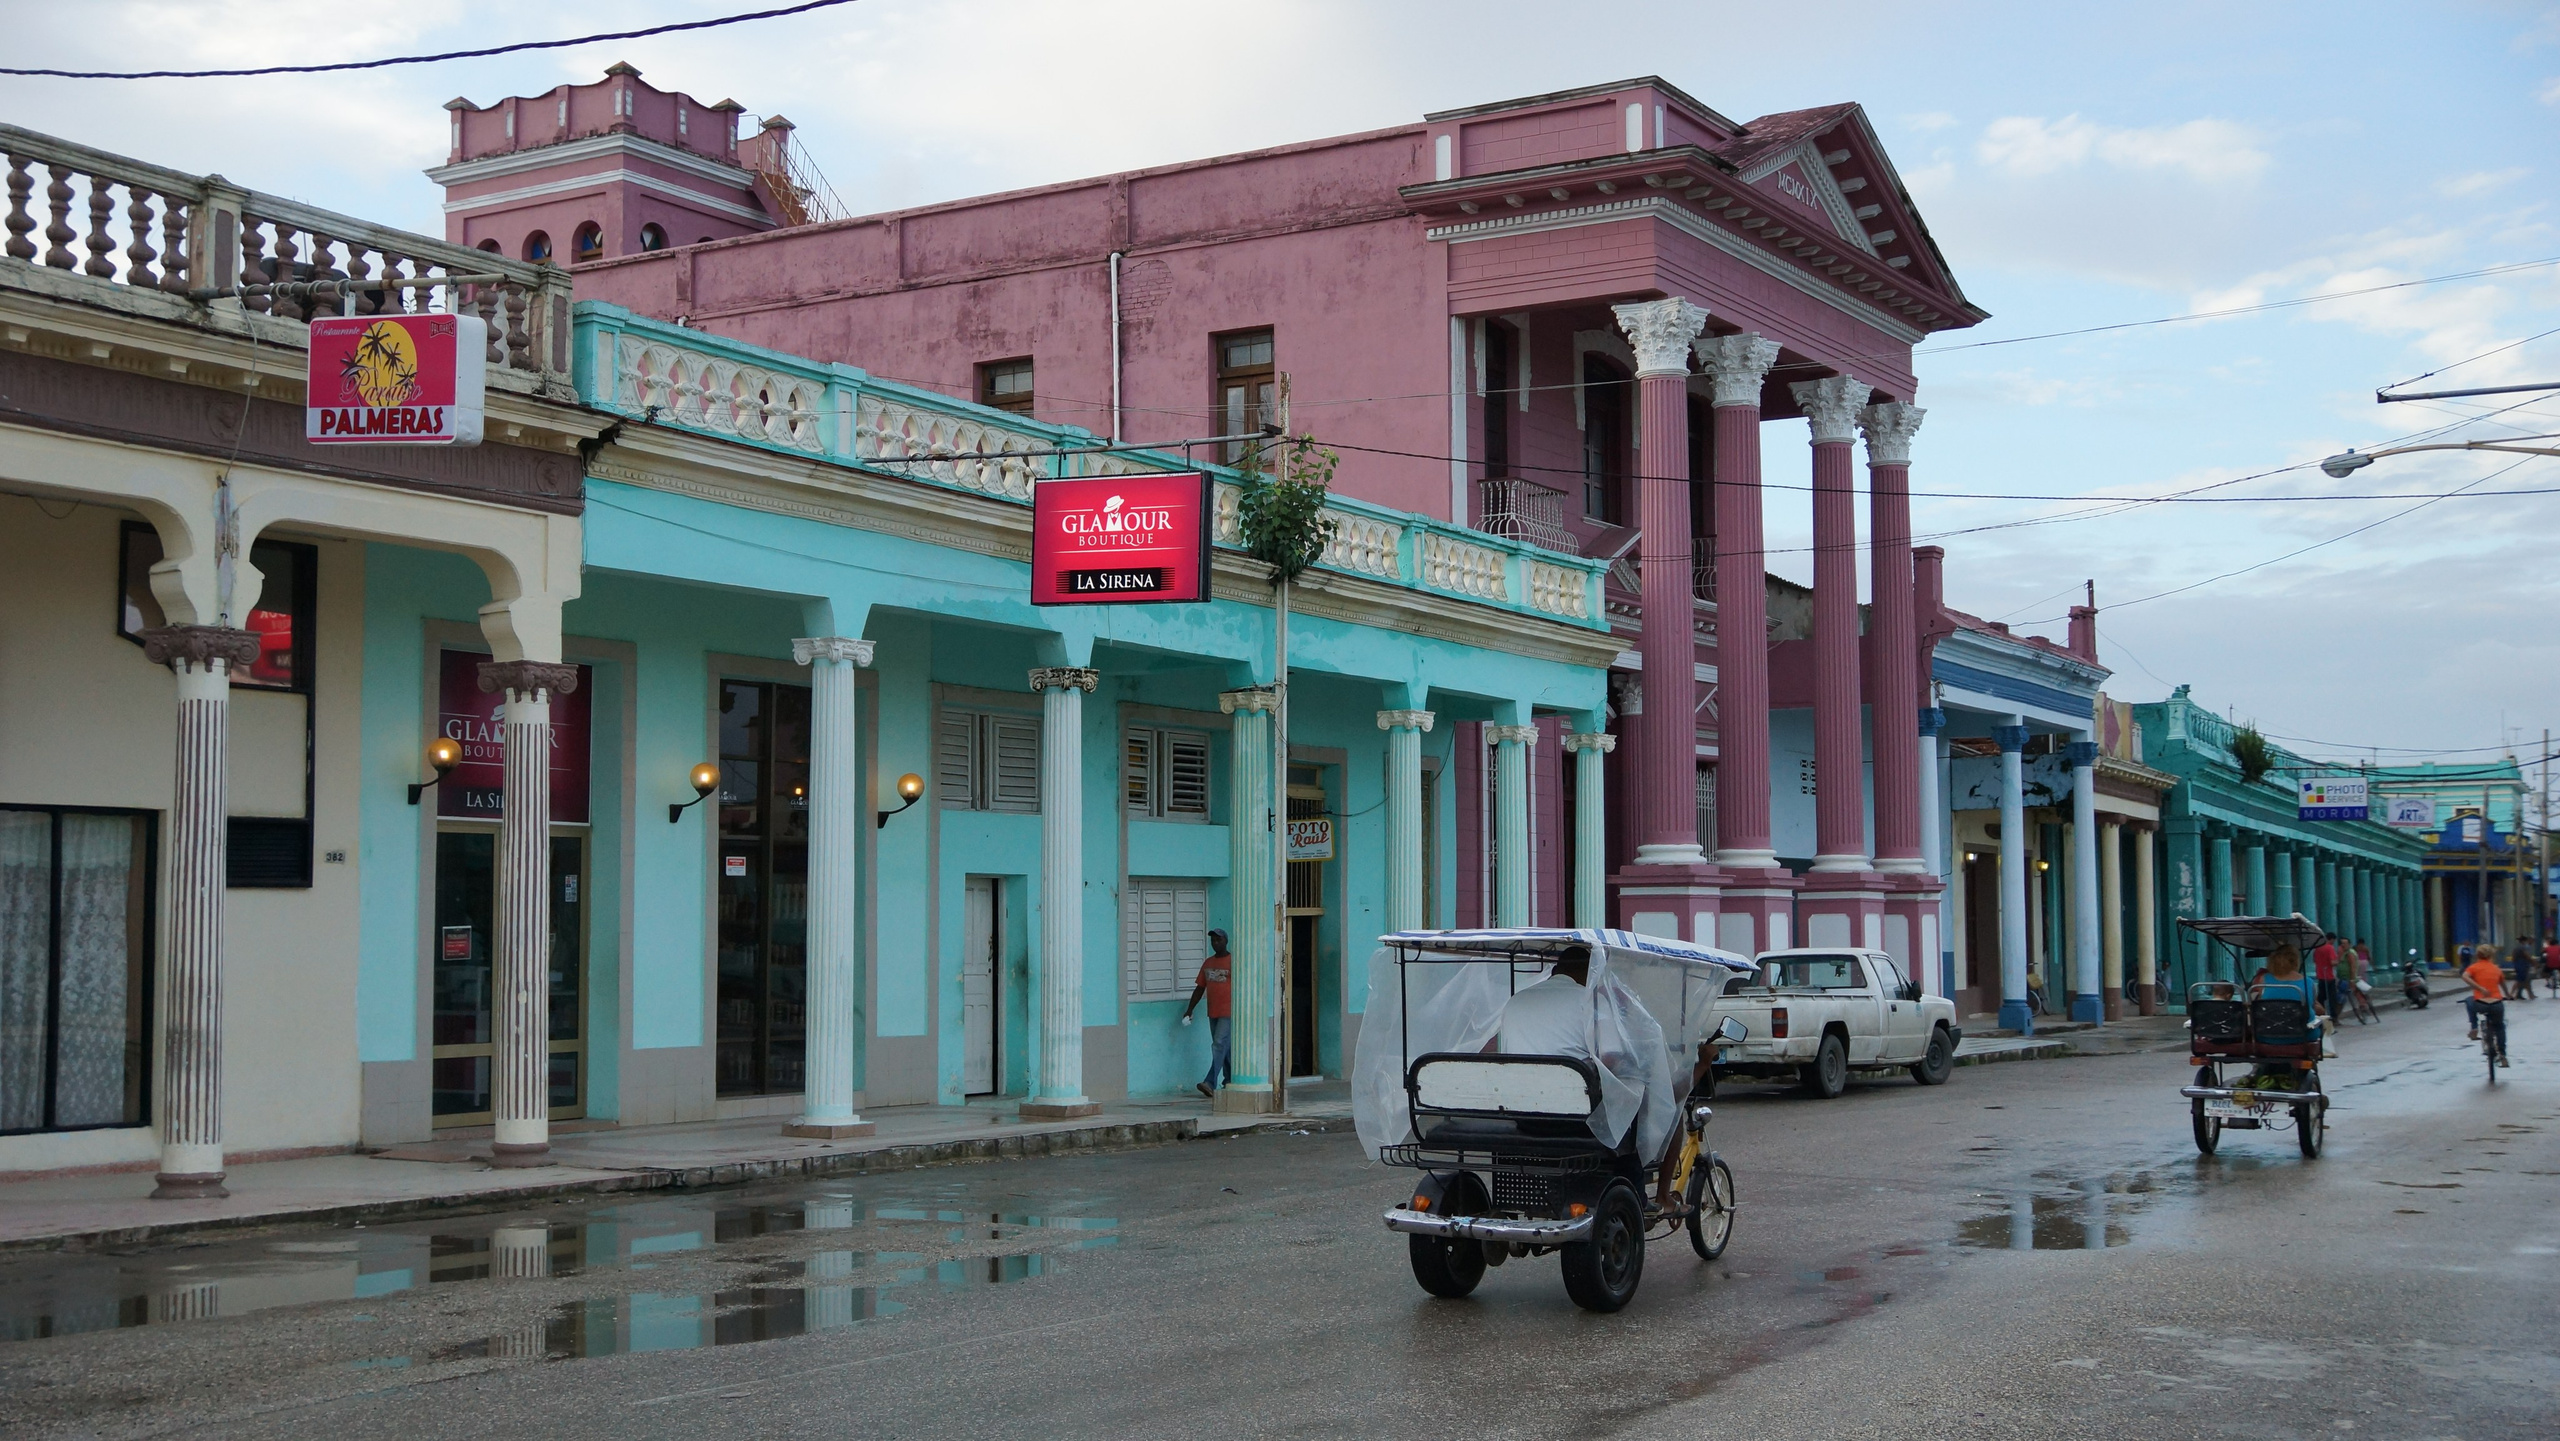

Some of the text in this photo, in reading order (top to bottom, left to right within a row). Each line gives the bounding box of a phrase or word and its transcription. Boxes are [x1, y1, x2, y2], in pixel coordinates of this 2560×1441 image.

[312, 321, 361, 337] Restaurante
[320, 406, 444, 435] PALMERAS
[1061, 511, 1174, 534] GLAMOUR
[1078, 533, 1154, 547] BOUTIQUE
[1077, 573, 1155, 590] LA SIRENA
[446, 718, 560, 749] GLAMR
[2326, 784, 2365, 795] PHOTO
[466, 791, 483, 808] LA
[2326, 795, 2364, 804] SERVICE
[1287, 821, 1329, 835] FOTO
